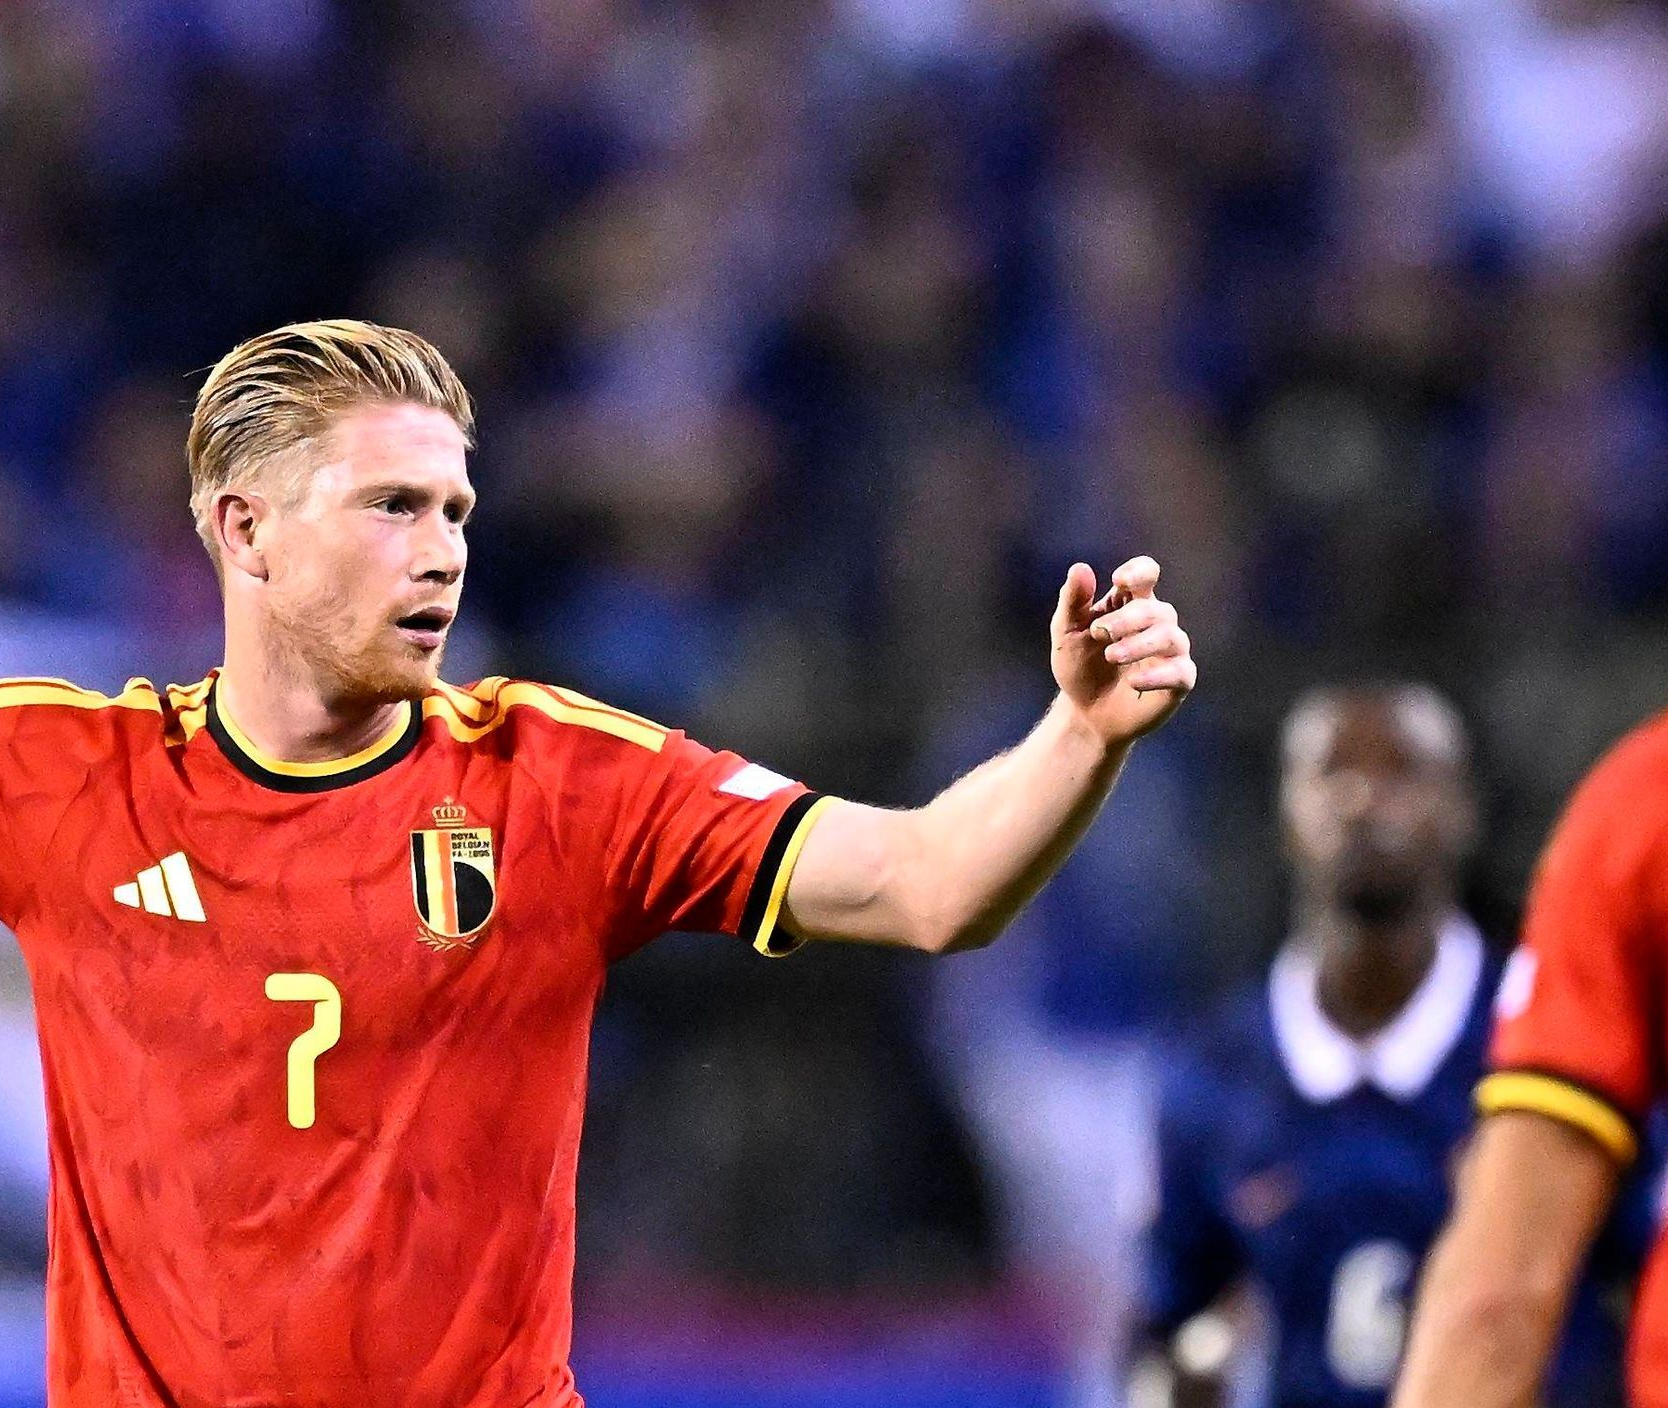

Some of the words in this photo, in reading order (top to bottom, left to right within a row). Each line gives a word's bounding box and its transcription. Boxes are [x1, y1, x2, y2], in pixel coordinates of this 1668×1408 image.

[451, 832, 479, 840] ROYAL
[265, 972, 341, 1128] 7
[1328, 1240, 1414, 1389] 6
